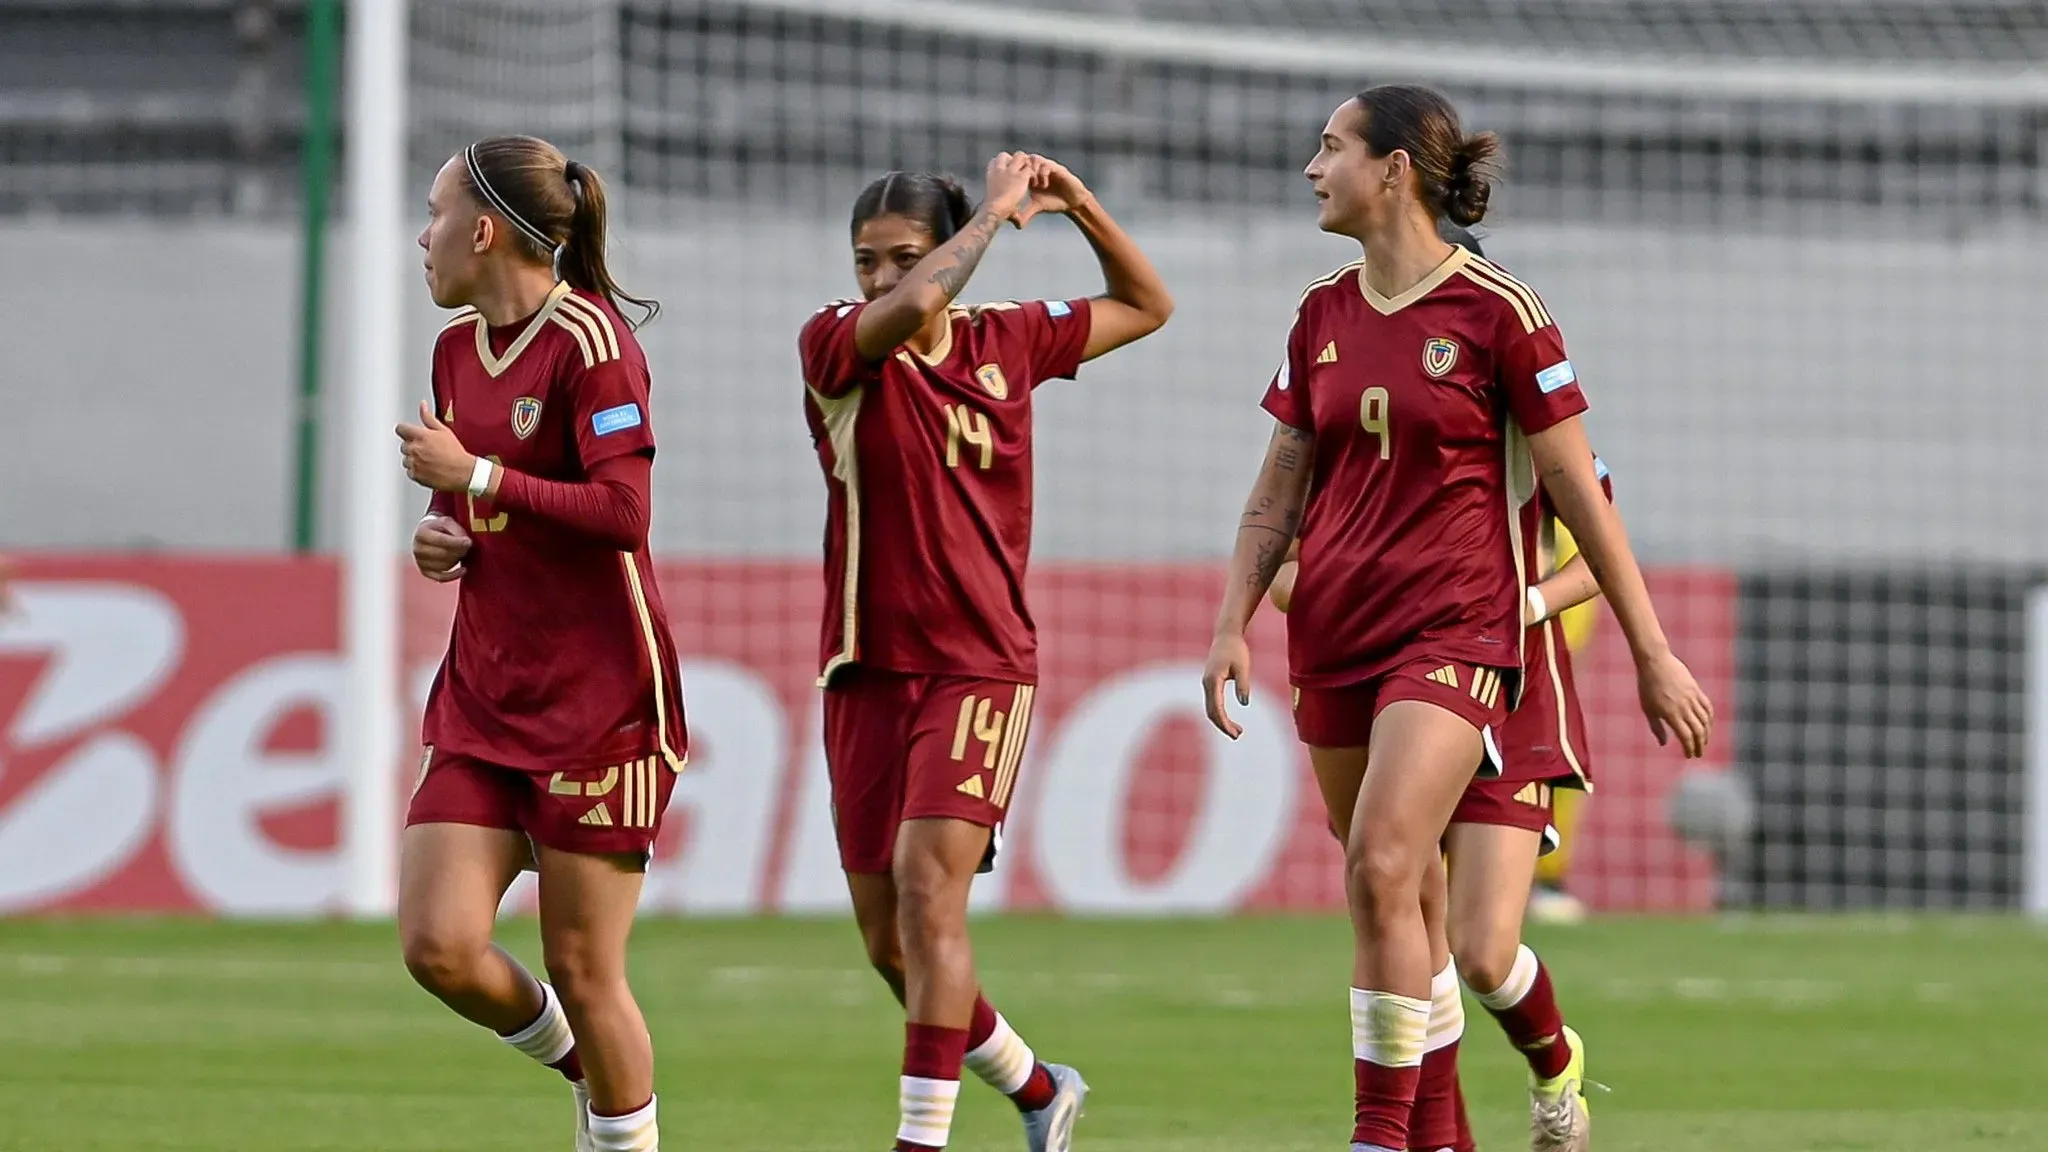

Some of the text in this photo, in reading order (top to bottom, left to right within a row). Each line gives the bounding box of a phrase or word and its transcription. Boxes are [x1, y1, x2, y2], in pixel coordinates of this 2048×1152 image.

[943, 403, 993, 469] 14
[1360, 386, 1391, 460] 9
[0, 581, 1300, 914] Beao
[950, 694, 1005, 769] 14
